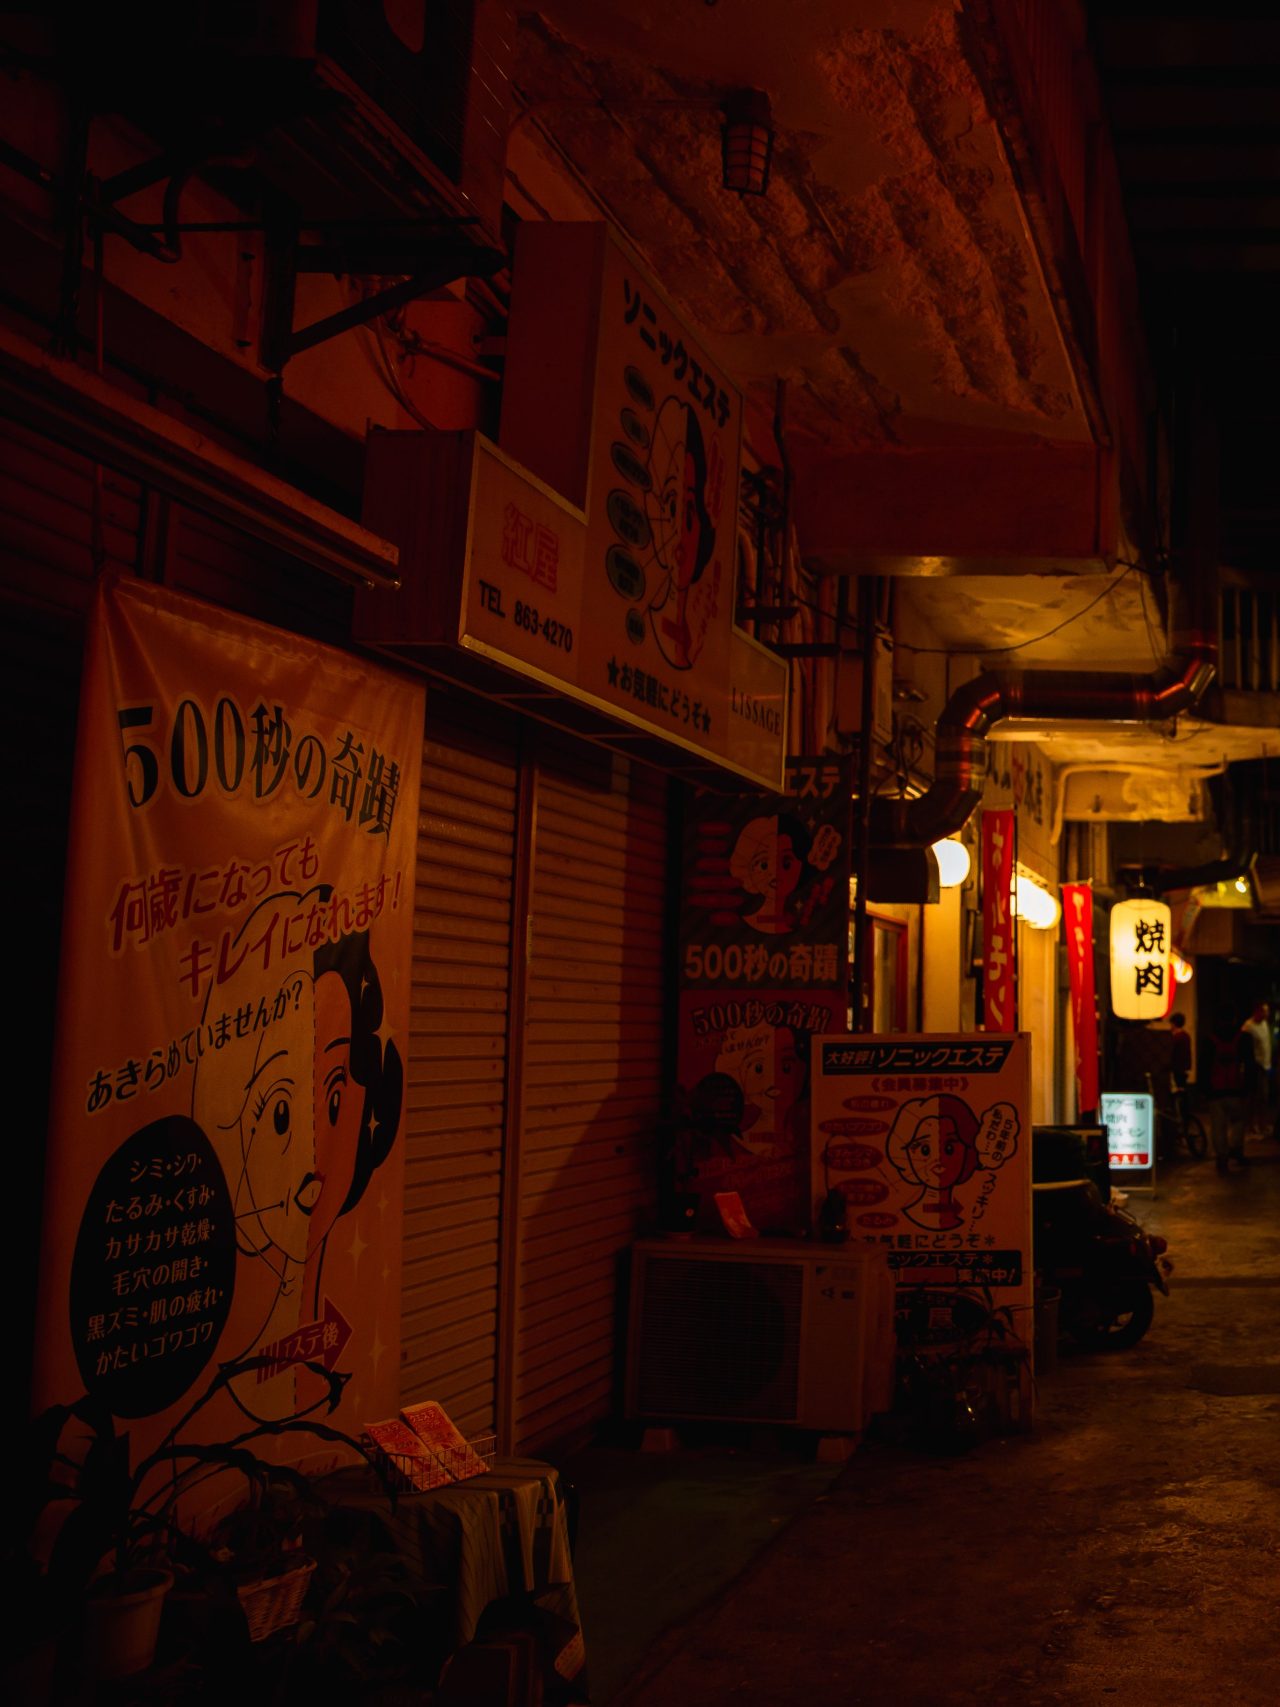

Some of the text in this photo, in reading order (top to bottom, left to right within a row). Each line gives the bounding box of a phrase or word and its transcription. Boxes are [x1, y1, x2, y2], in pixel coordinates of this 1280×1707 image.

[623, 278, 730, 428] ソニックエステ
[503, 502, 560, 592] 紅屋
[479, 579, 506, 620] TEL
[514, 600, 573, 653] 863-4270
[732, 687, 781, 737] LISSAGE
[117, 697, 402, 842] 500秒の奇蹟
[109, 836, 320, 951] 何歳になっても
[179, 871, 401, 997] キレイになれます!
[684, 943, 840, 983] 500秒の奇蹟
[1135, 919, 1165, 996] 焼肉
[86, 979, 303, 1114] あきらめていませんか?
[95, 1320, 215, 1377] かたいゴワゴワ
